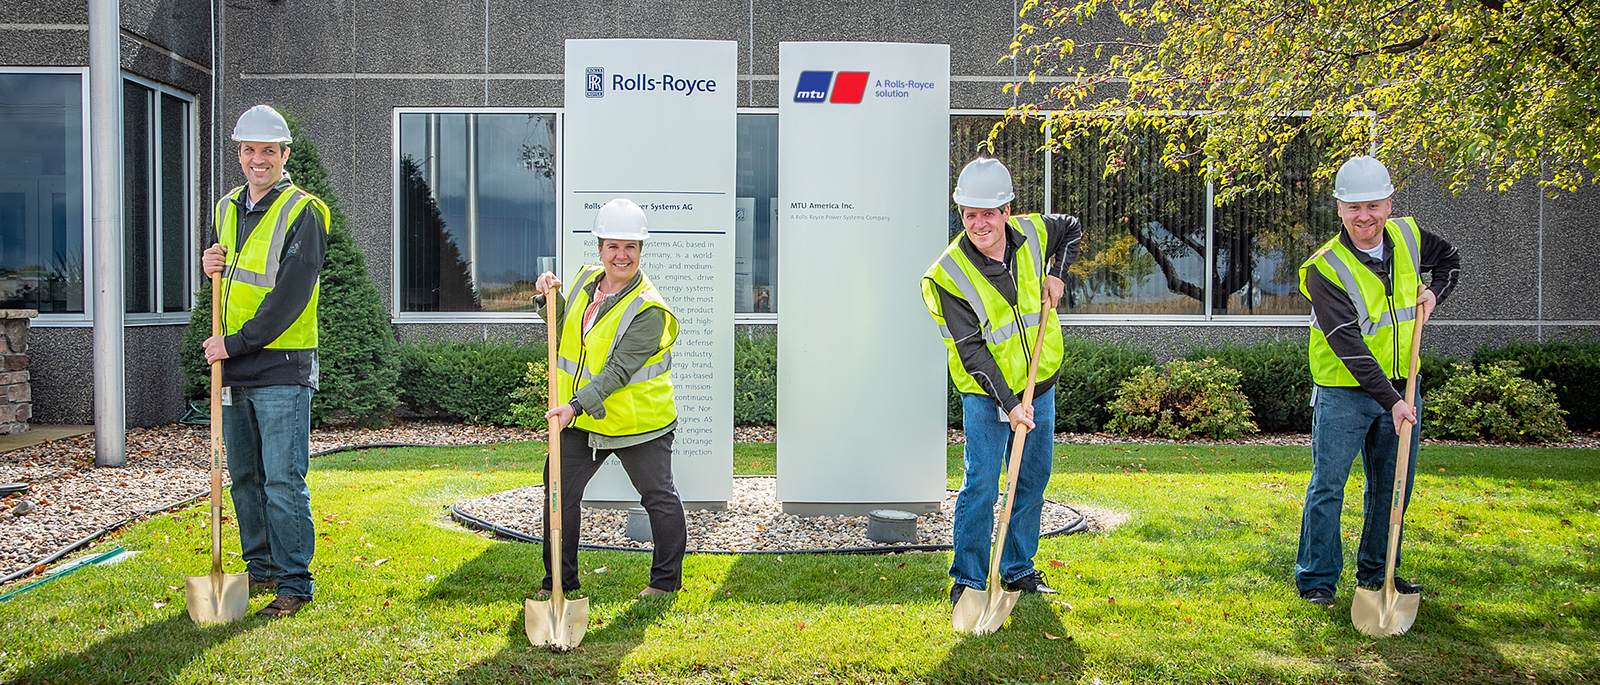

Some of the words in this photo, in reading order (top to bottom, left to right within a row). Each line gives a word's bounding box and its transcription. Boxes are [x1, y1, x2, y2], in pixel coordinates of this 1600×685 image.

[612, 74, 716, 96] Rolls-Royce
[875, 80, 882, 88] A
[884, 80, 934, 90] Rolls-Royce
[797, 90, 825, 98] mtu
[876, 90, 909, 98] solution
[650, 202, 680, 212] Systems
[643, 241, 670, 249] Systems
[684, 351, 713, 359] industry.
[680, 372, 713, 381] gas-based
[679, 416, 700, 424] ngines
[683, 449, 712, 457] injection
